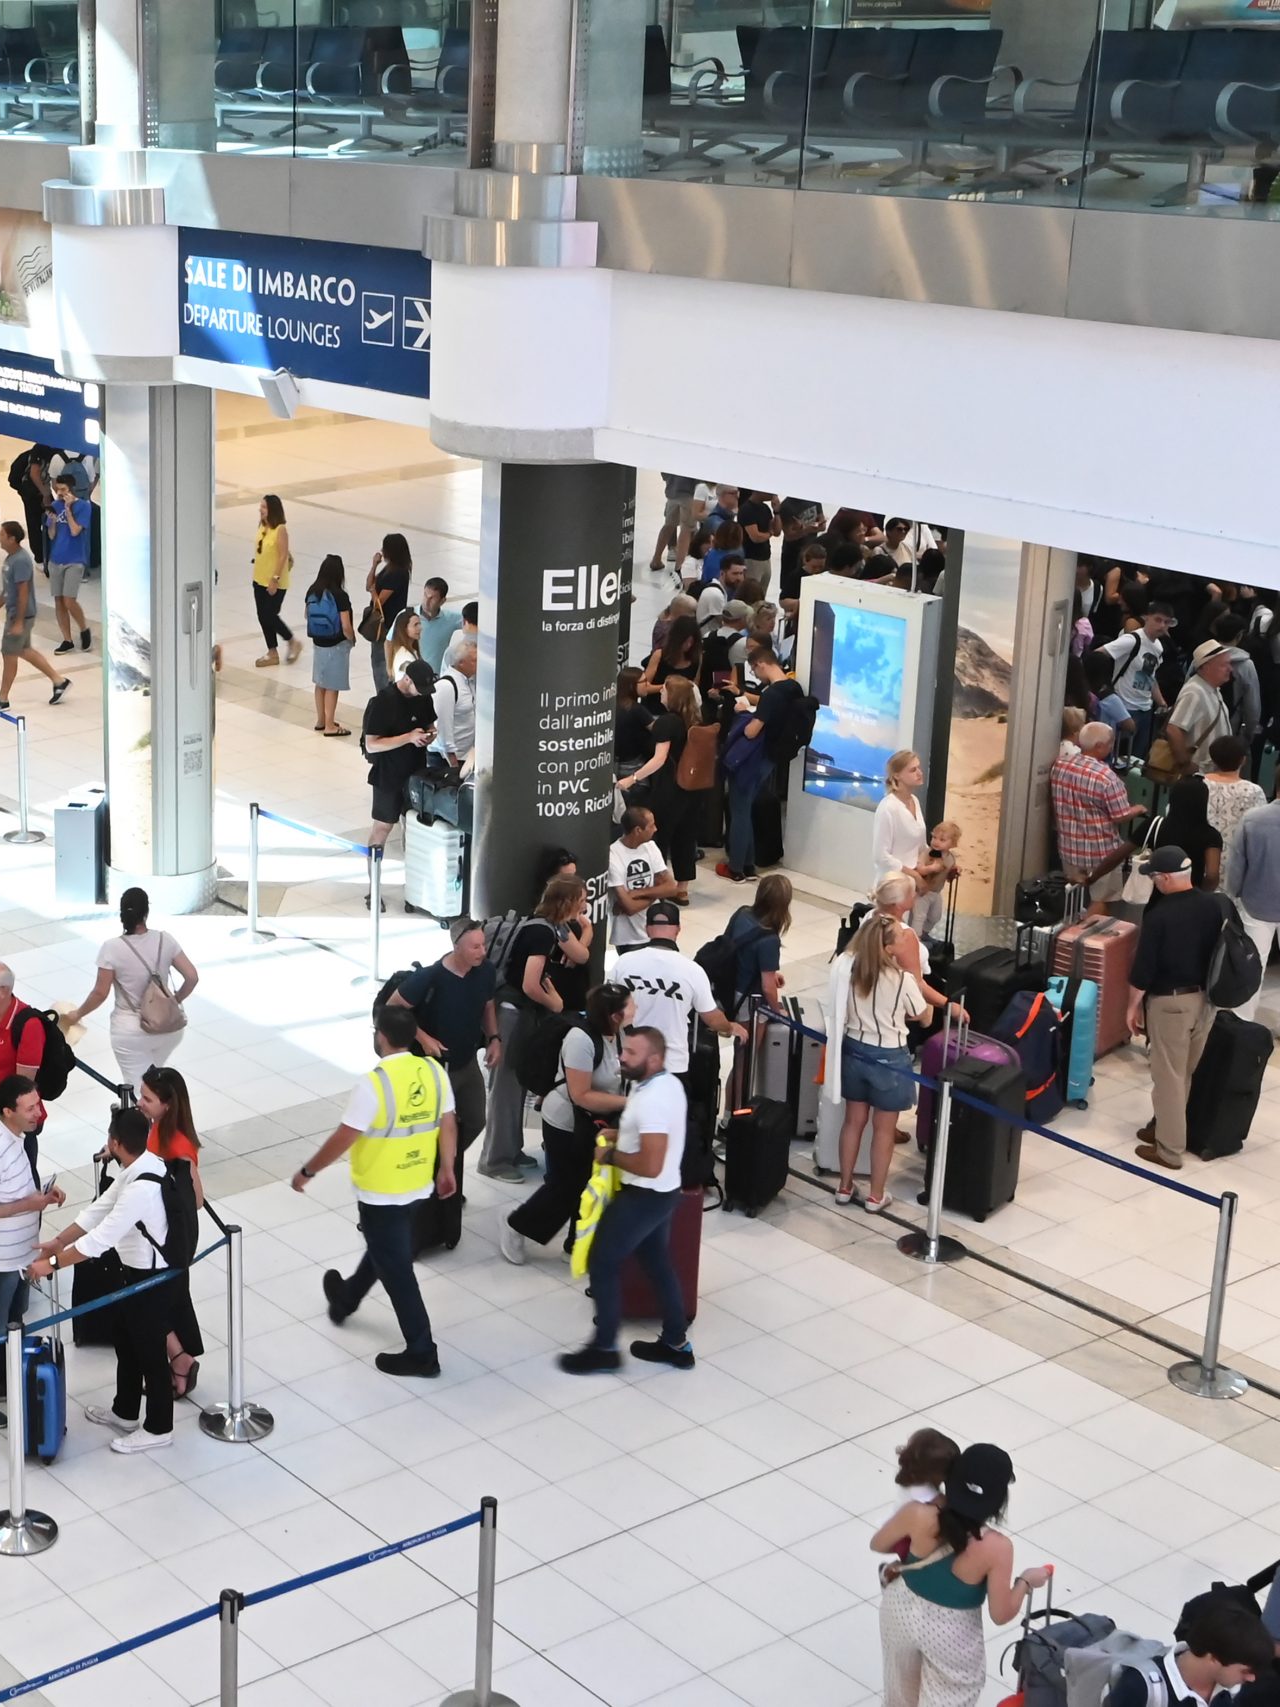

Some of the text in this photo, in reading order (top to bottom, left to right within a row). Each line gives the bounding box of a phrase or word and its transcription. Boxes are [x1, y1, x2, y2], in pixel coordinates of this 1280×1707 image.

[184, 256, 356, 306] SALE DI IMBARCO
[183, 303, 341, 348] DEPARTURE LOUNGES
[542, 564, 622, 611] Elle
[542, 620, 553, 632] la
[555, 619, 584, 632] forza
[586, 618, 595, 629] di
[540, 692, 549, 708] Il
[555, 691, 600, 711] primo
[539, 709, 612, 730] dall'anima
[538, 728, 614, 751] sostenibile
[537, 750, 611, 776] con profilo
[537, 778, 590, 795] in PVC
[536, 801, 580, 817] 100%
